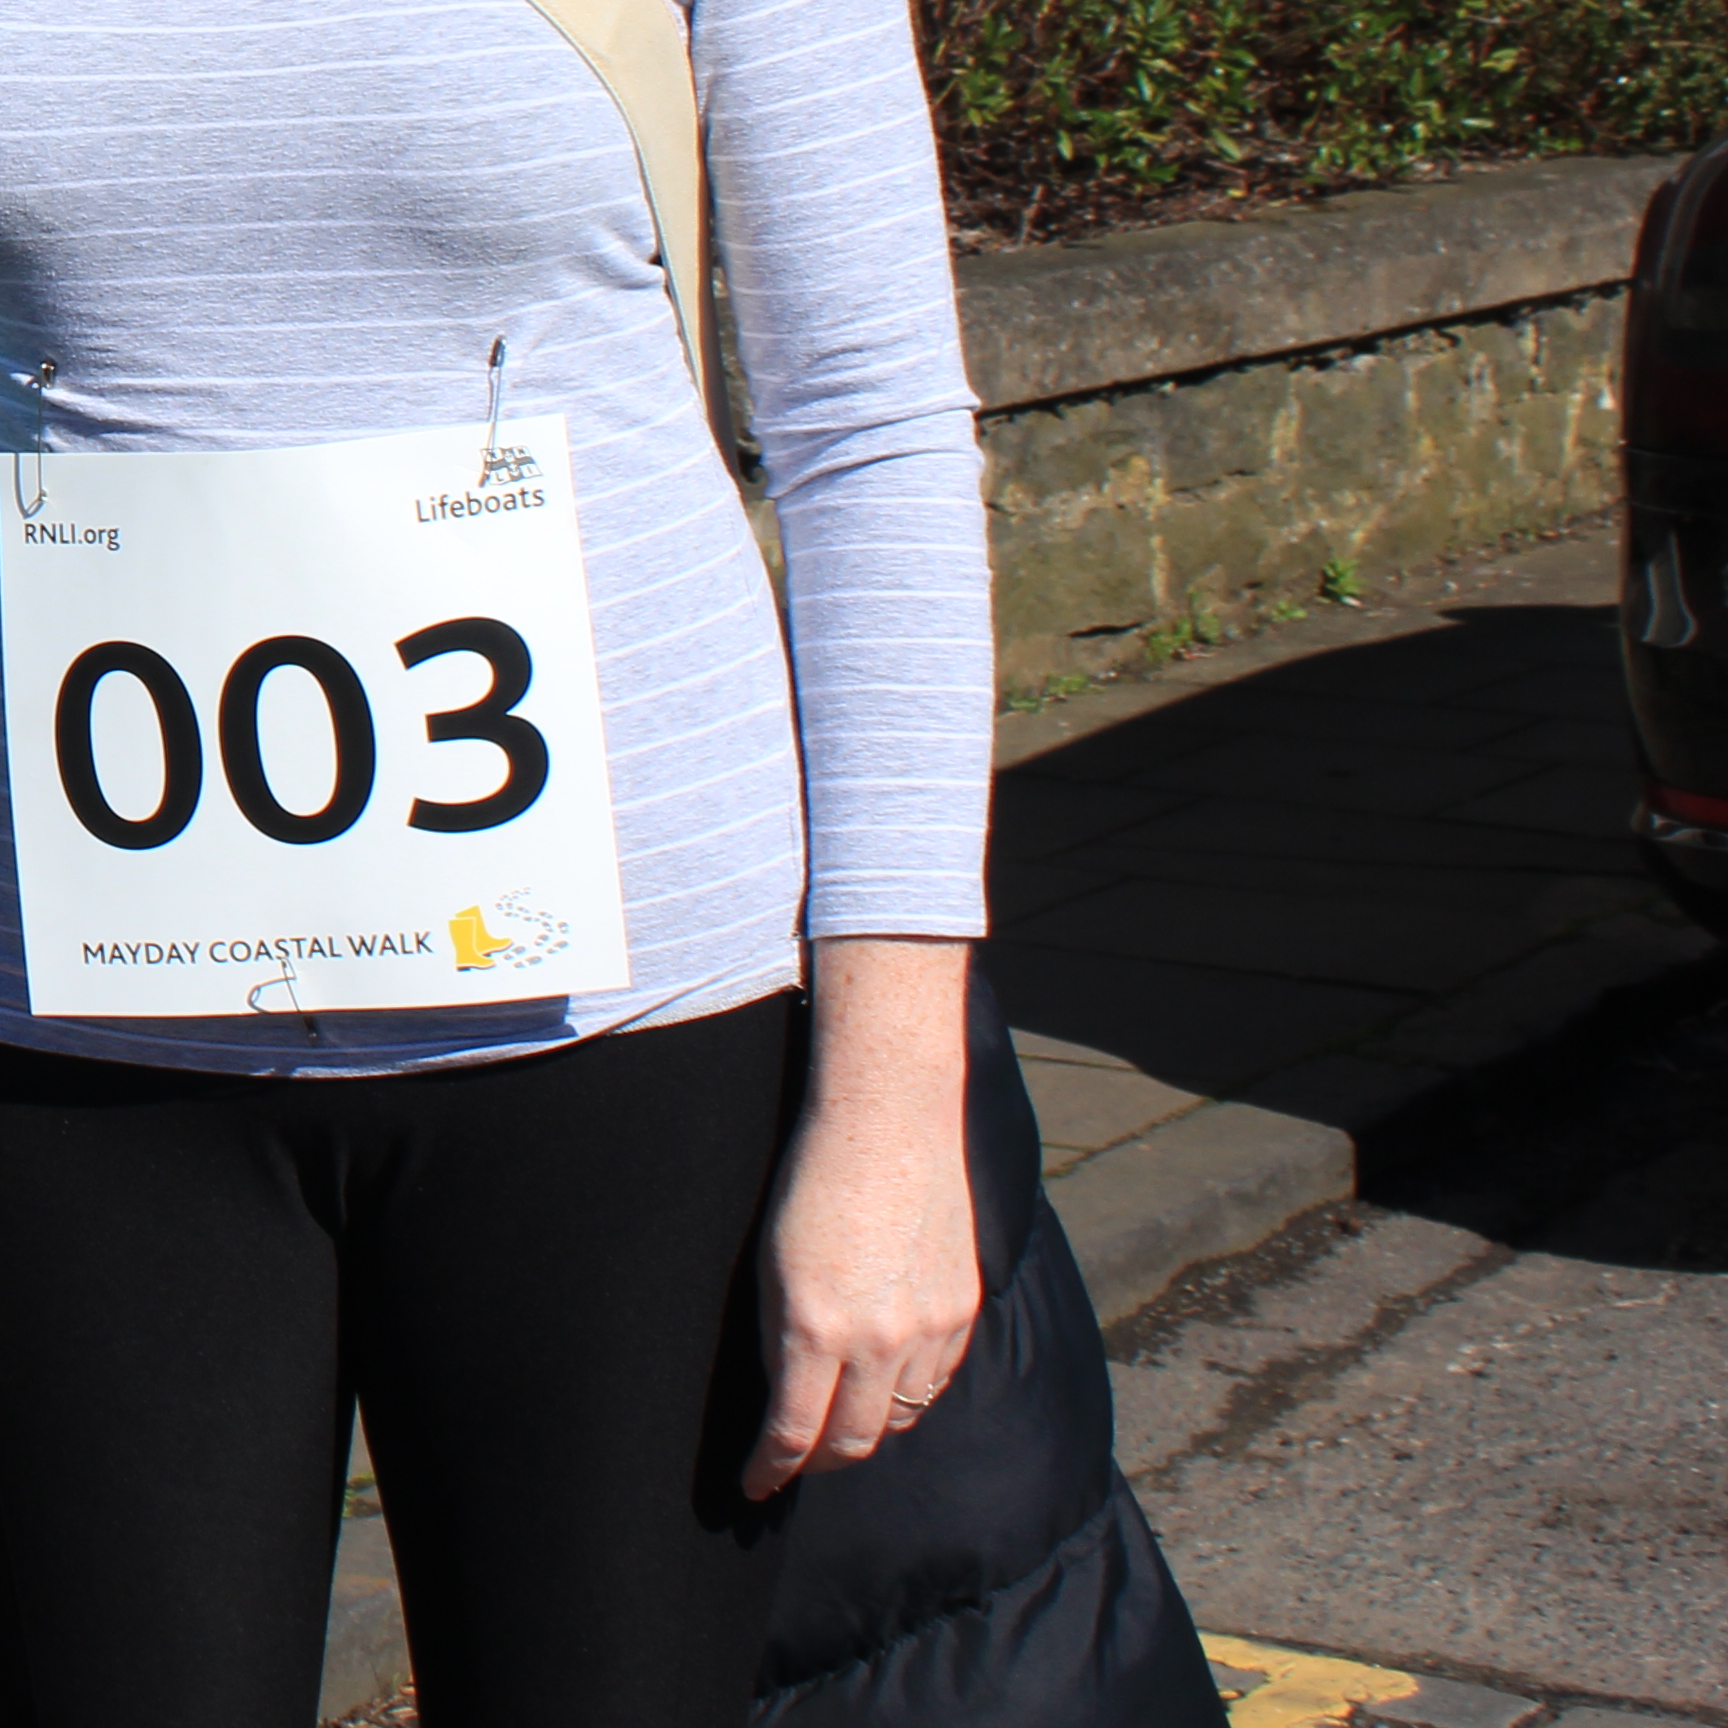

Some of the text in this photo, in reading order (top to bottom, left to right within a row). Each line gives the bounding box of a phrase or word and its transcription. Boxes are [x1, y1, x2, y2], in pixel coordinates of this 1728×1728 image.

[414, 486, 545, 523] Lifeboats
[24, 522, 121, 552] RNLI.org
[54, 615, 550, 851] 003
[81, 930, 433, 966] MAYDAY COASTAL WALK
